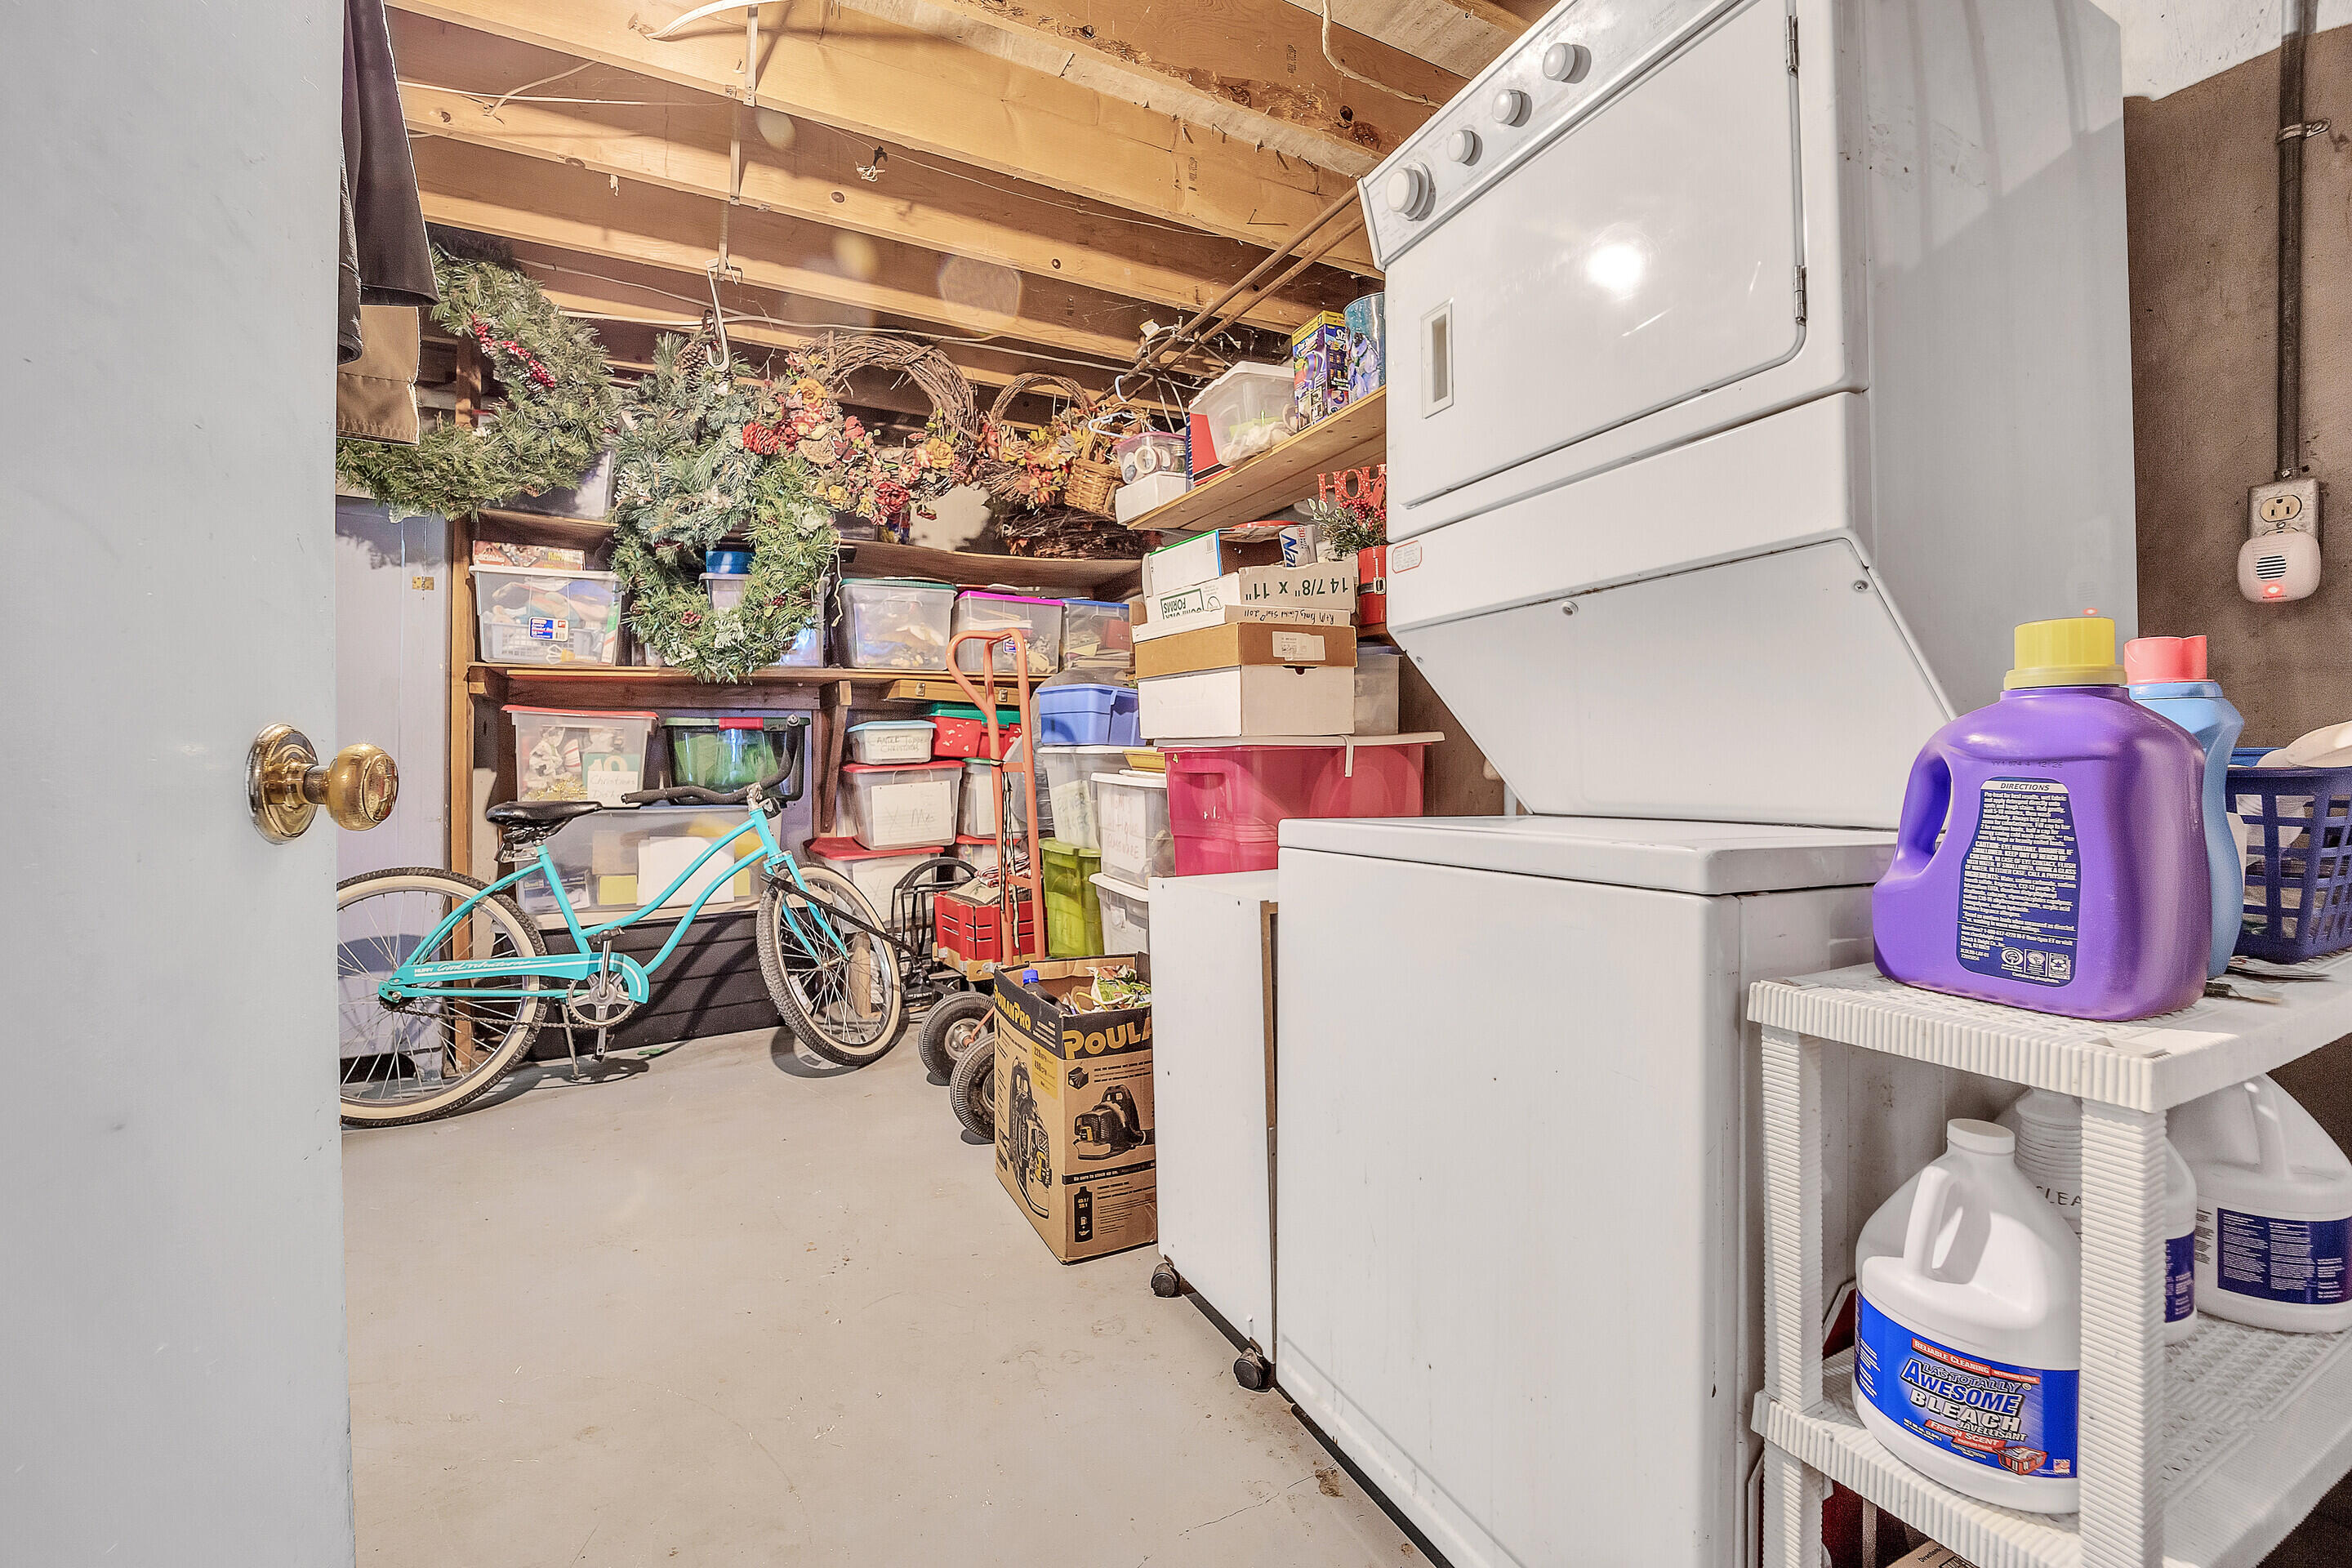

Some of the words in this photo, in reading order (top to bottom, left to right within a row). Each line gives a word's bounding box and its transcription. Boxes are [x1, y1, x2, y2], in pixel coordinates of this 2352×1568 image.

[1245, 582, 1270, 600] 11"
[1295, 578, 1326, 596] 7/8"
[1330, 577, 1348, 593] 14
[1163, 598, 1187, 613] FORMS
[2000, 783, 2051, 791] DIRECTIONS
[1914, 1341, 1949, 1361] RELIABLE
[1950, 1356, 1989, 1374] CLEANING
[1901, 1358, 2022, 1415] AWESOME
[1951, 1374, 2021, 1392] TOTALLY
[1910, 1389, 2021, 1432] BLEACH
[1931, 1422, 1962, 1437] FRESH
[1965, 1433, 1999, 1446] SCENT
